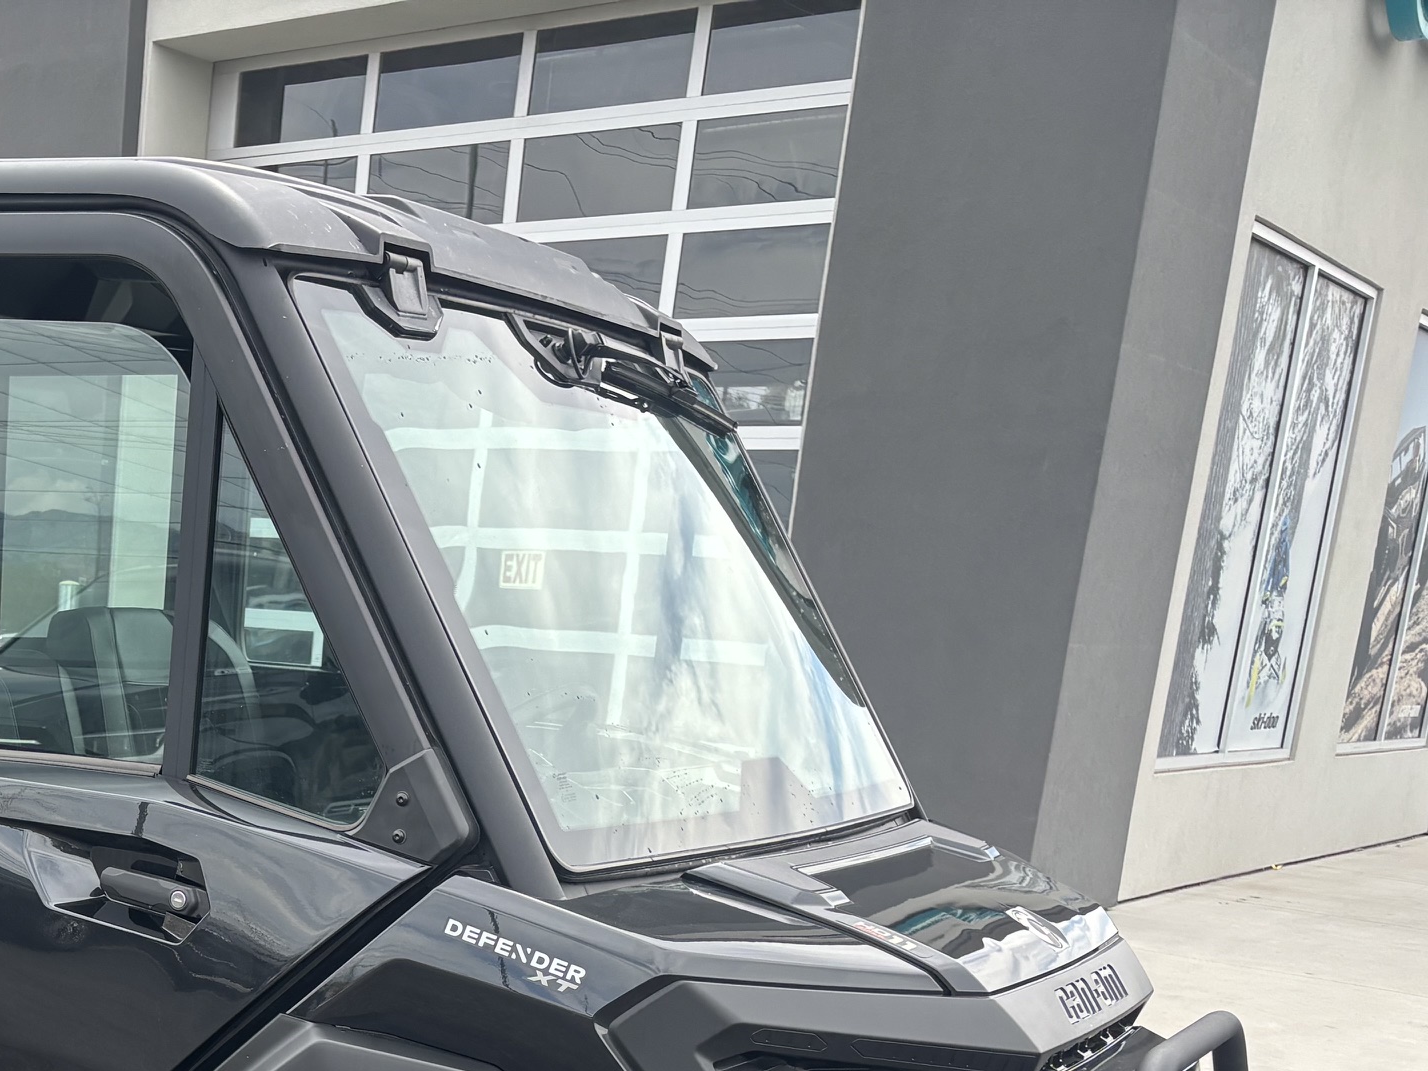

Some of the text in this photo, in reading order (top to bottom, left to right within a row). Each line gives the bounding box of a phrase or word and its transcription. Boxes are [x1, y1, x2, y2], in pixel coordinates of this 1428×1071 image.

[502, 553, 542, 584] EXIT
[1250, 712, 1279, 730] ski-doo
[444, 918, 587, 984] DEFENDER
[527, 970, 579, 993] XT
